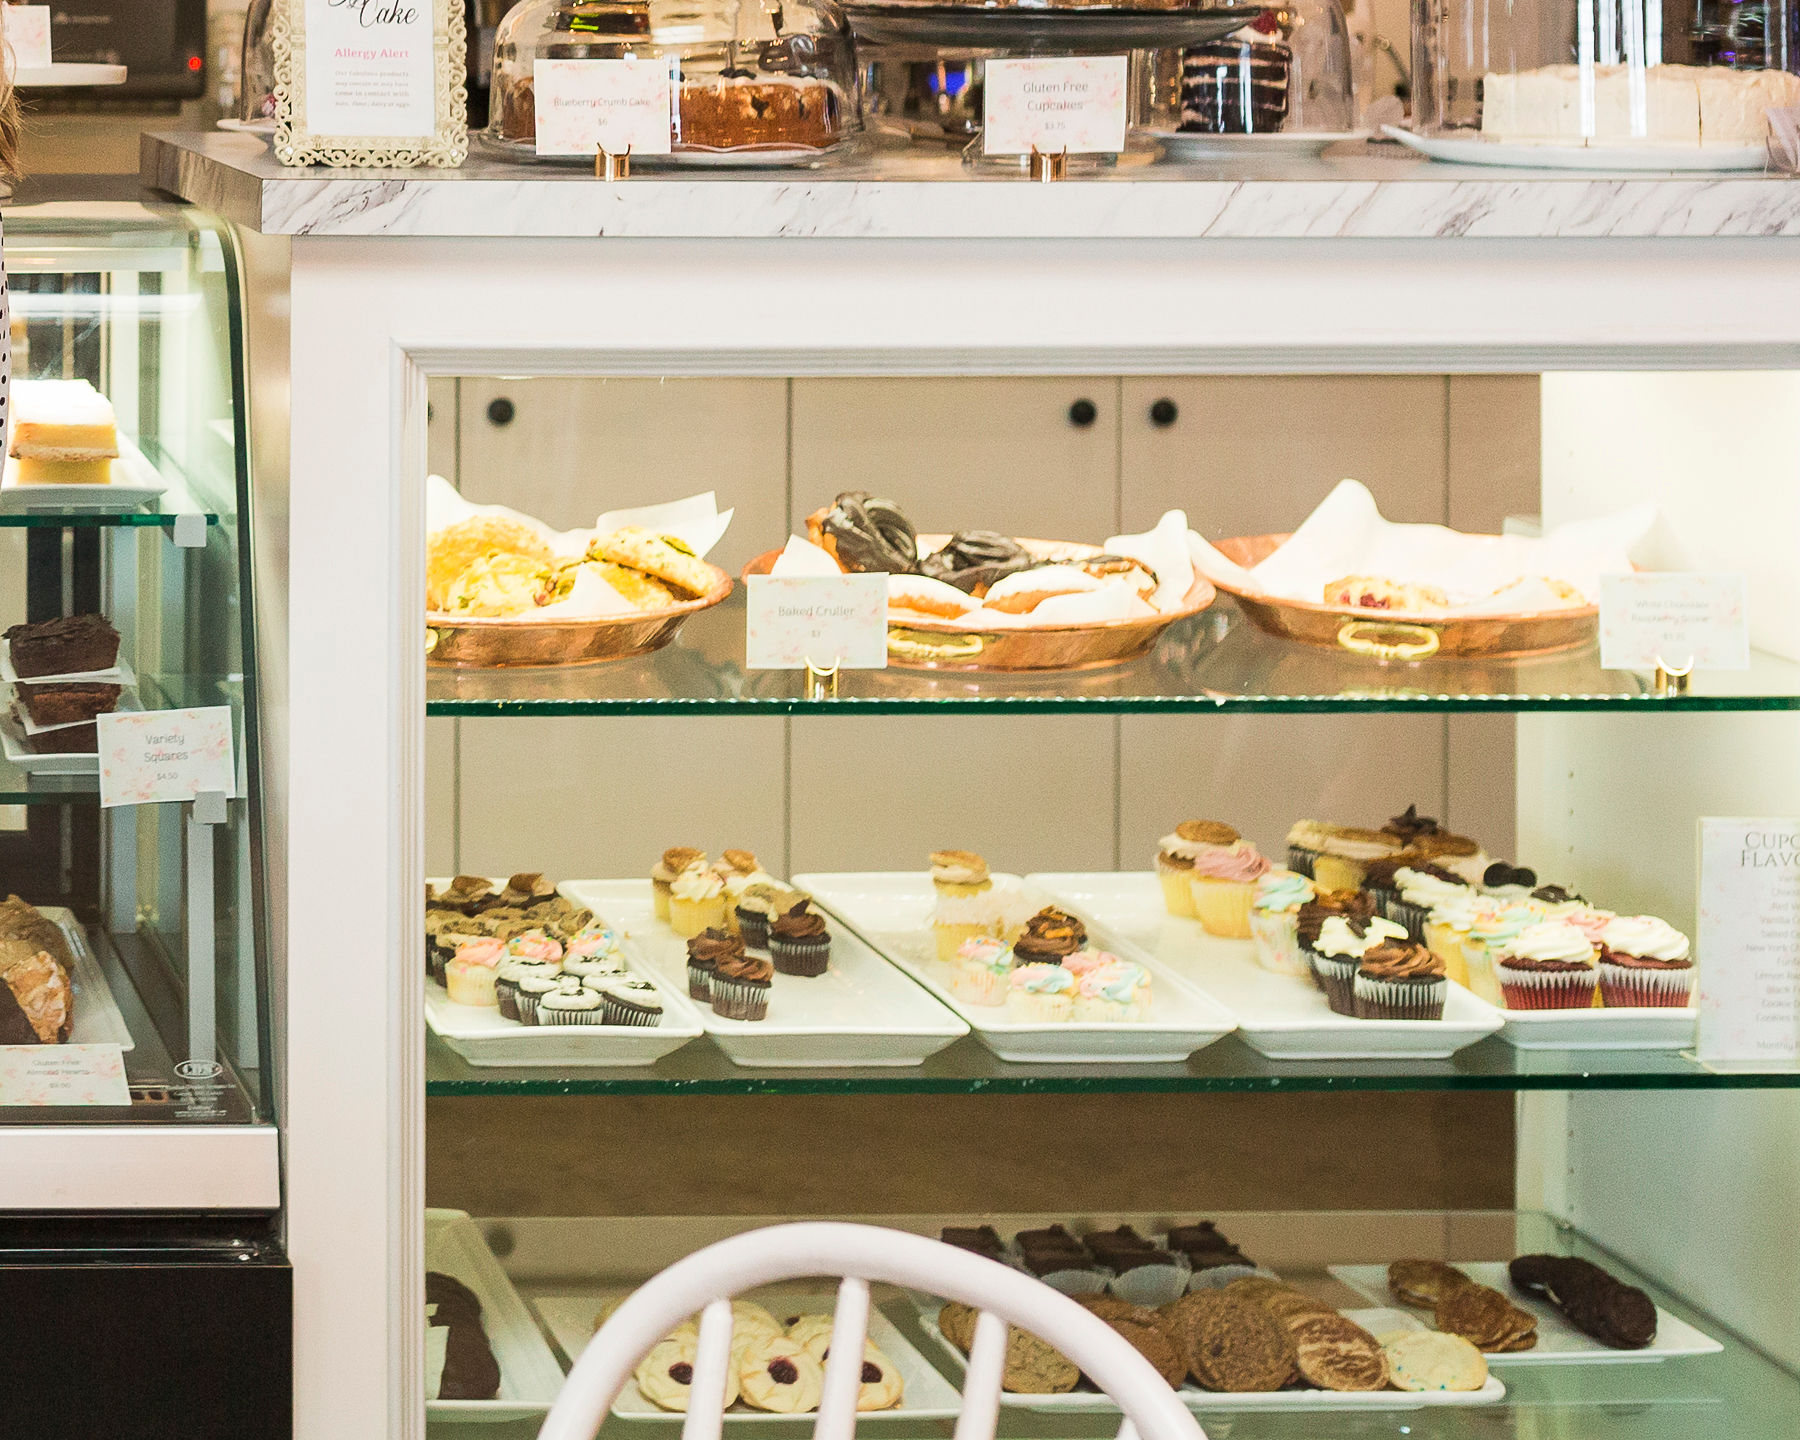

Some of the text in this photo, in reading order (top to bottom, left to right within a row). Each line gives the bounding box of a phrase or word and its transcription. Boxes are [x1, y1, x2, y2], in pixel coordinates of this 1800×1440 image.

[334, 48, 409, 60] Allergy Alert
[1023, 81, 1088, 93] Gluten Free
[554, 98, 650, 108] Blueberry Crumb Cake
[1027, 100, 1084, 112] Cupcakes
[778, 605, 855, 617] Baked Cruller
[146, 734, 185, 746] Variety
[144, 751, 189, 764] Squares
